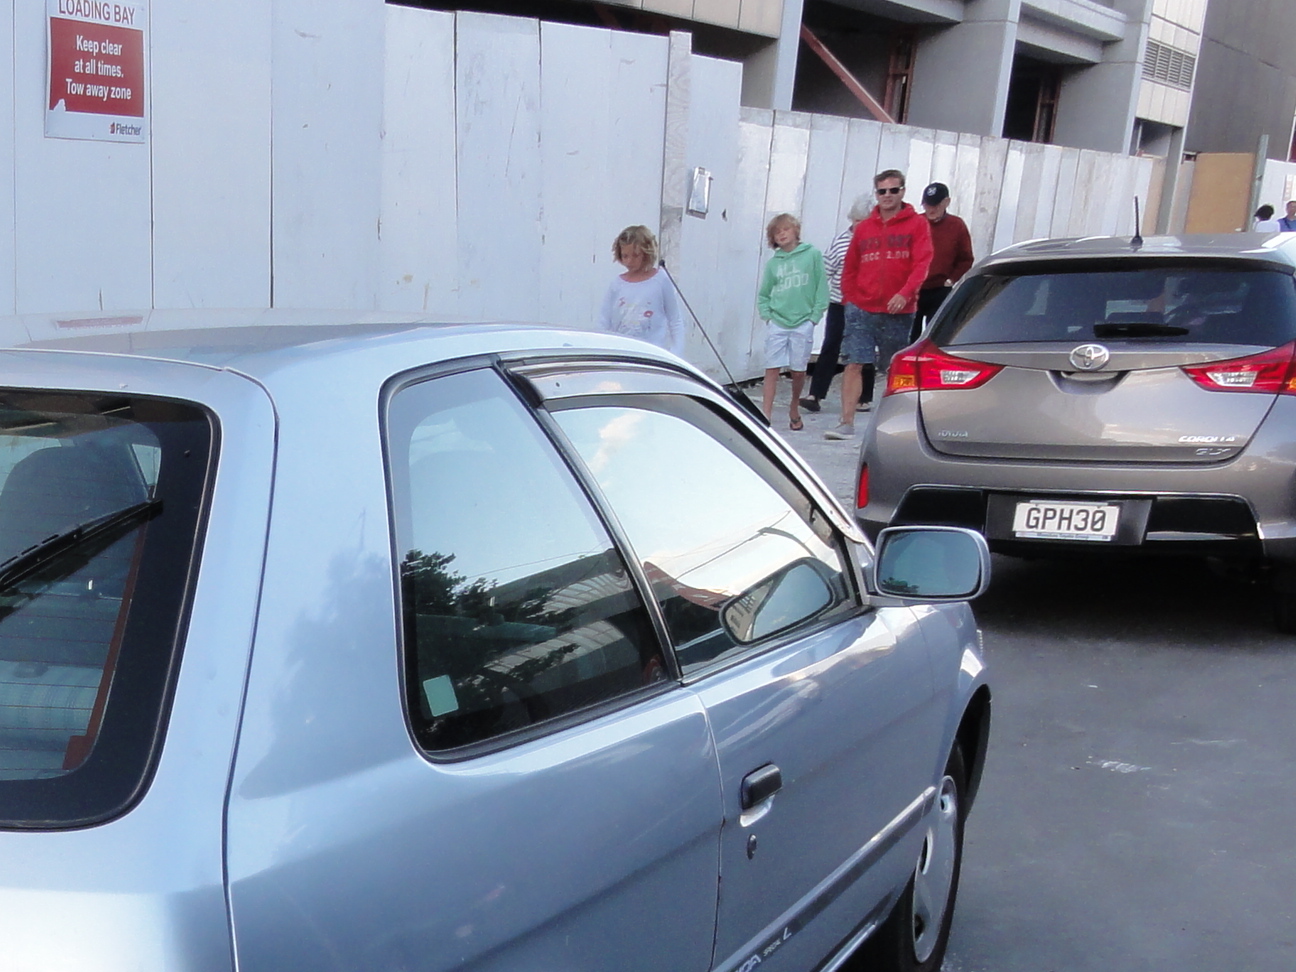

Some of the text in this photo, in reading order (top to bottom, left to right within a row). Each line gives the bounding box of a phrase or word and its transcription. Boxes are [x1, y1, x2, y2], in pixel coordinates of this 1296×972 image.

[58, 0, 136, 25] LOADING BAY
[76, 34, 122, 56] Keep clear
[74, 58, 124, 78] at all times.
[65, 78, 132, 102] Tow away zone
[115, 122, 142, 136] Fletcher
[1025, 507, 1107, 533] GPH30
